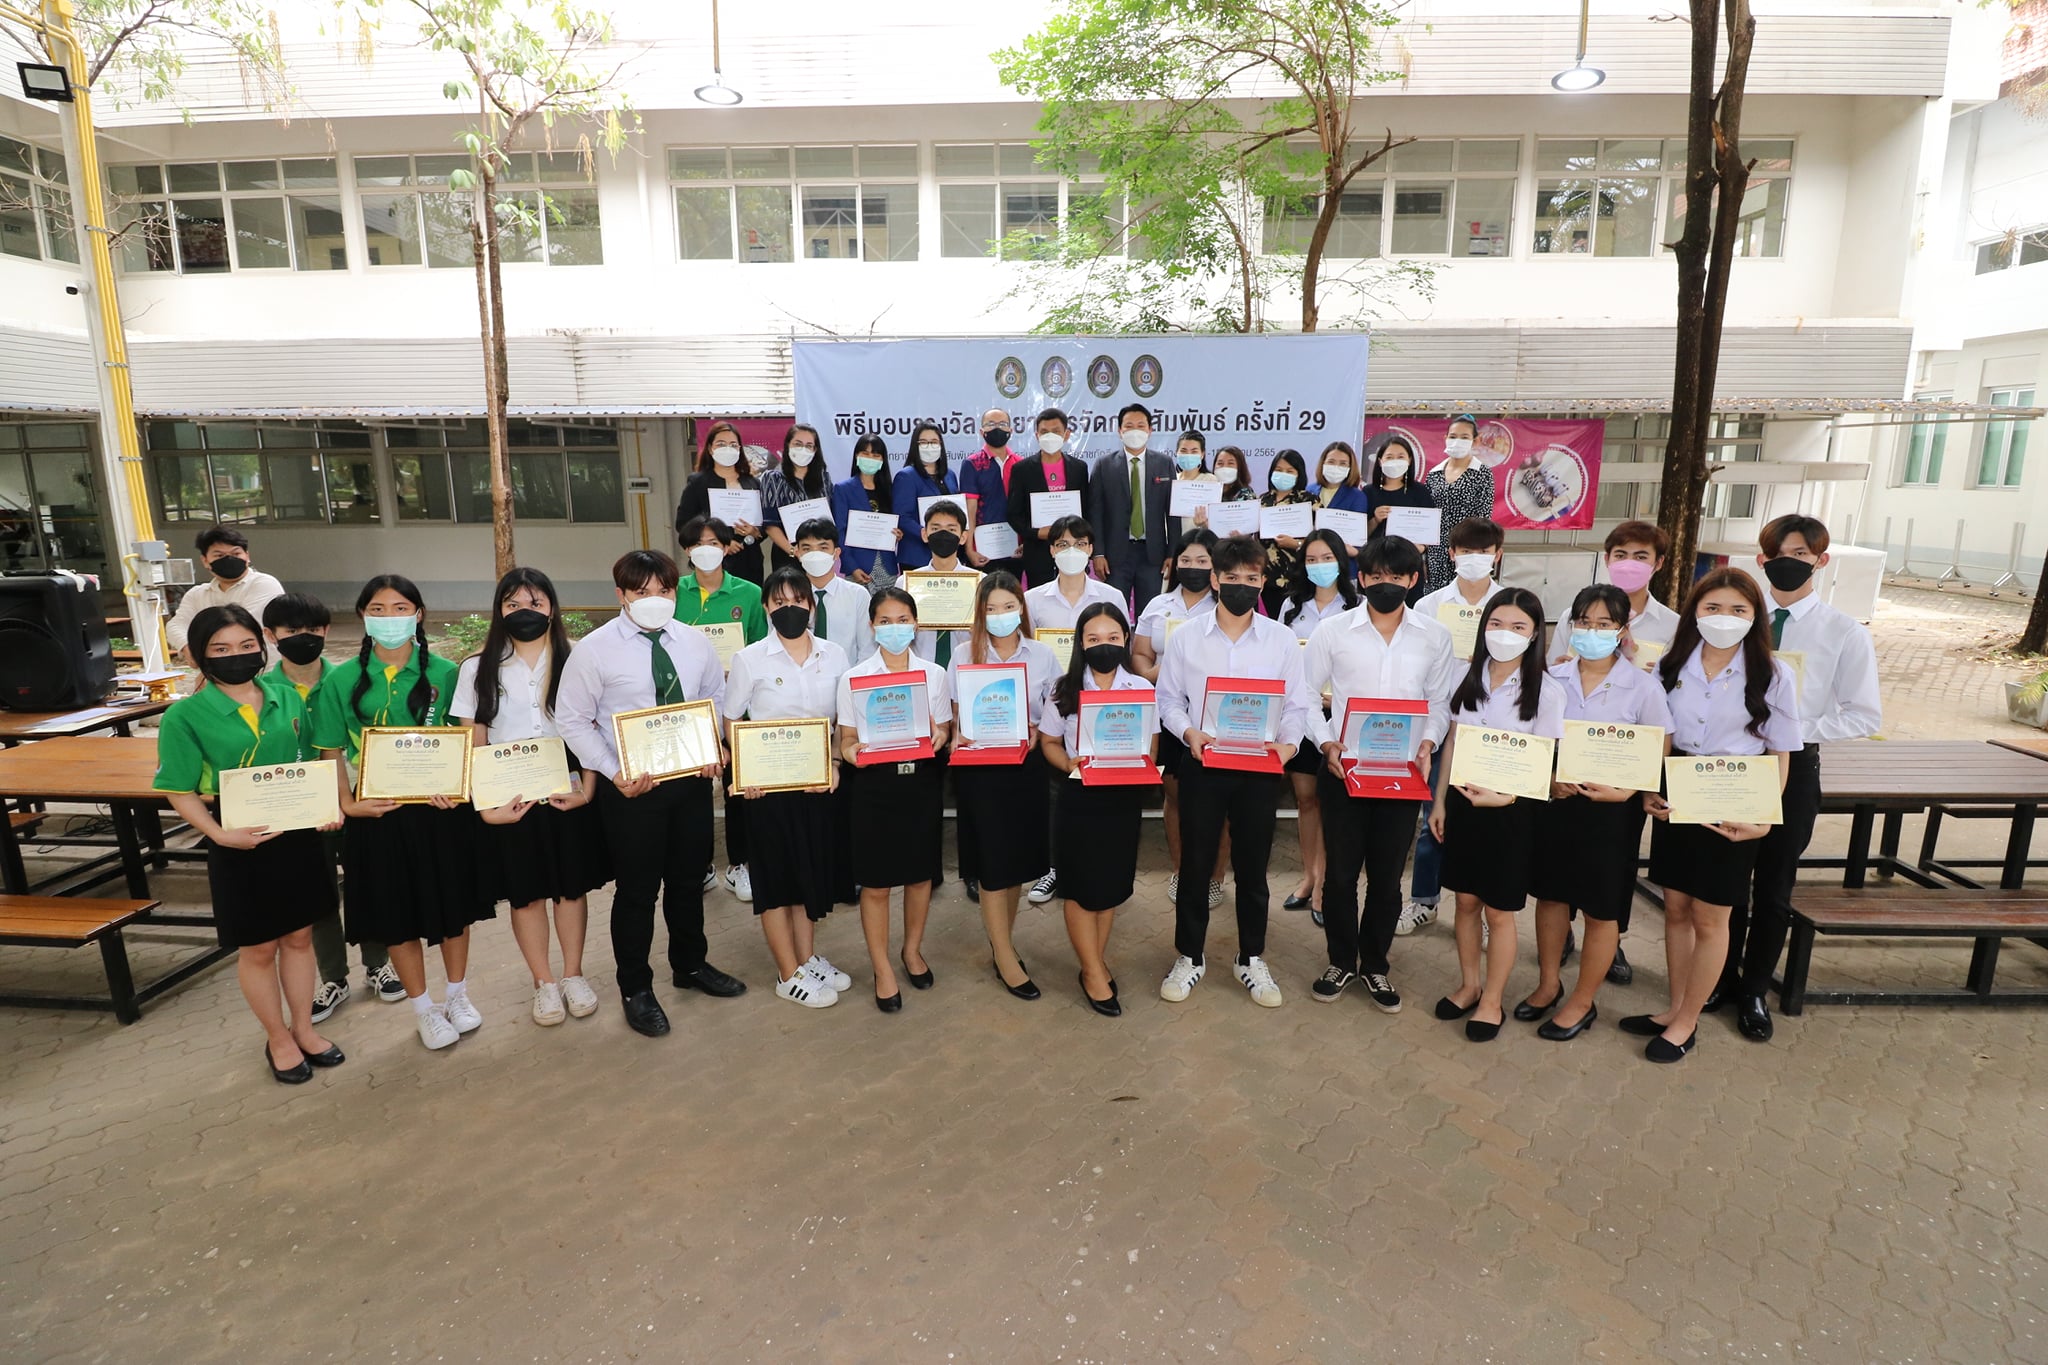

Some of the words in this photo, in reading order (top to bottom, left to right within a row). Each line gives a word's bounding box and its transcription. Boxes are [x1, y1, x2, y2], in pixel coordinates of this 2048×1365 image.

[1235, 400, 1292, 431] ครั้งที่
[1298, 410, 1327, 431] 29
[1254, 447, 1276, 457] 2565
